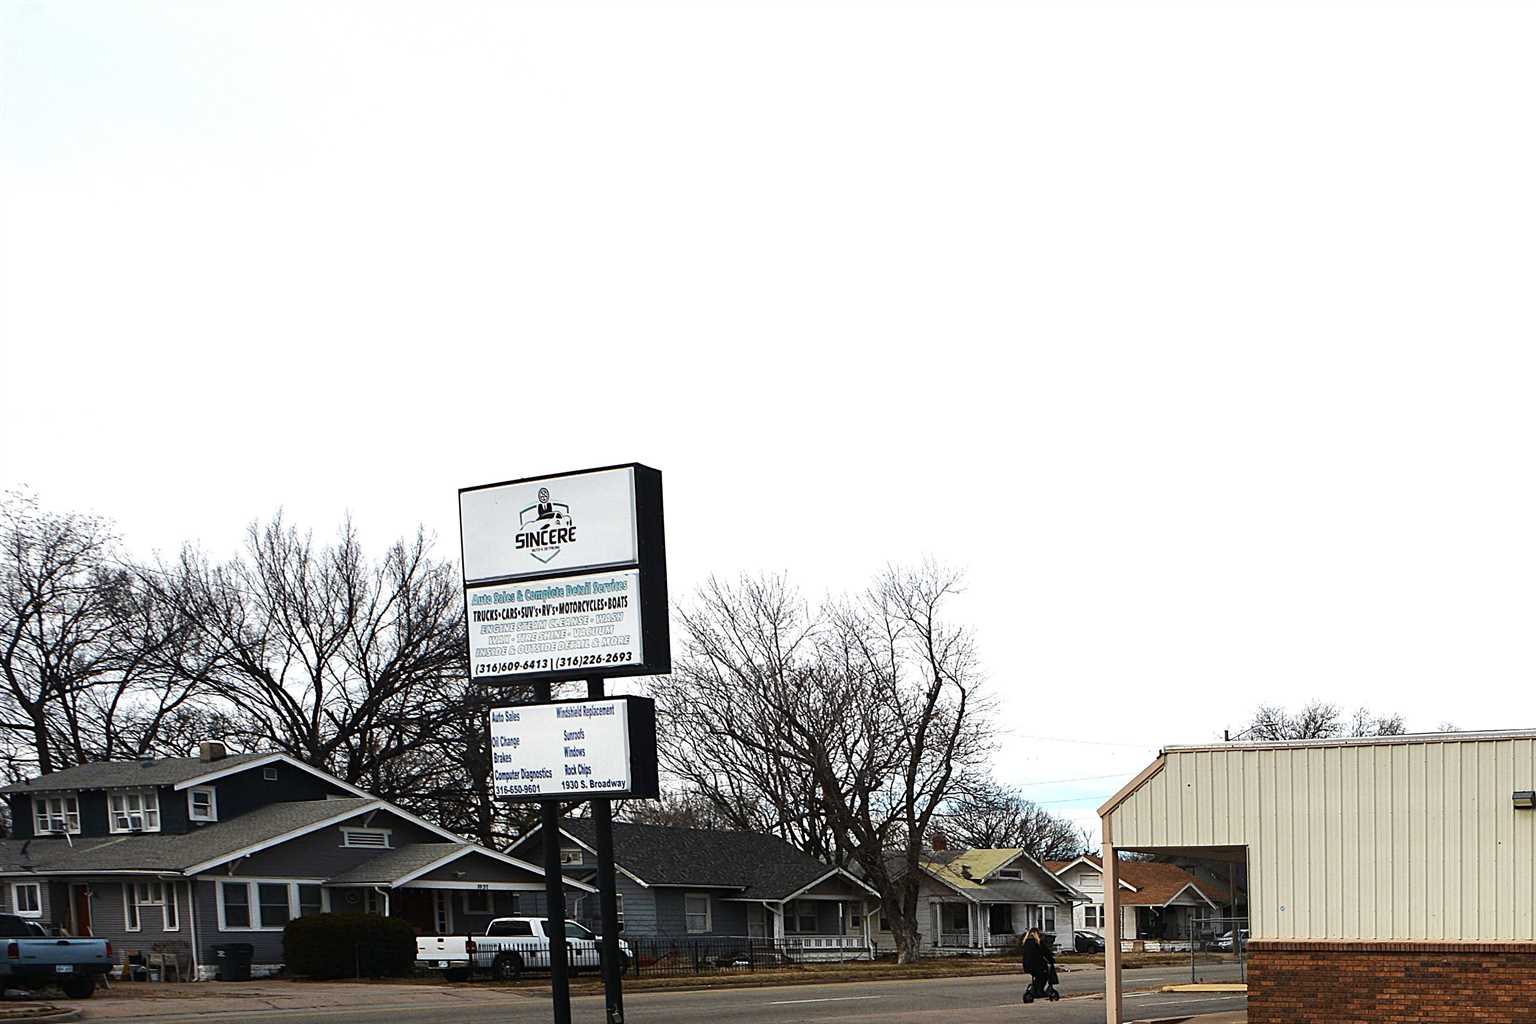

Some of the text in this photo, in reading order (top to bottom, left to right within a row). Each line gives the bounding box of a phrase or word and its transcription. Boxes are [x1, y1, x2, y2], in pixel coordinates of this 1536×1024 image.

[515, 527, 576, 549] SINCERE
[472, 578, 628, 606] Auto Sales & Complete Detail Services
[480, 623, 515, 634] ENGINE
[595, 611, 625, 624] WASH
[538, 629, 567, 642] SHINE
[572, 625, 616, 638] VACUUM
[475, 646, 508, 657] INSIDE
[517, 641, 557, 654] OUTSIDE
[557, 639, 590, 651] DETAIL
[601, 635, 631, 647] MORE
[492, 711, 520, 722] Auto Sales
[556, 704, 615, 719] Windshield Replacement
[564, 728, 584, 741] Sunroofs
[500, 736, 520, 749] Change
[494, 752, 512, 763] Brakes
[563, 745, 585, 757] Windows
[495, 768, 552, 783] Computer Diagnostics
[564, 763, 591, 777] Rock Chips
[561, 779, 626, 790] 1930 S. Broadway
